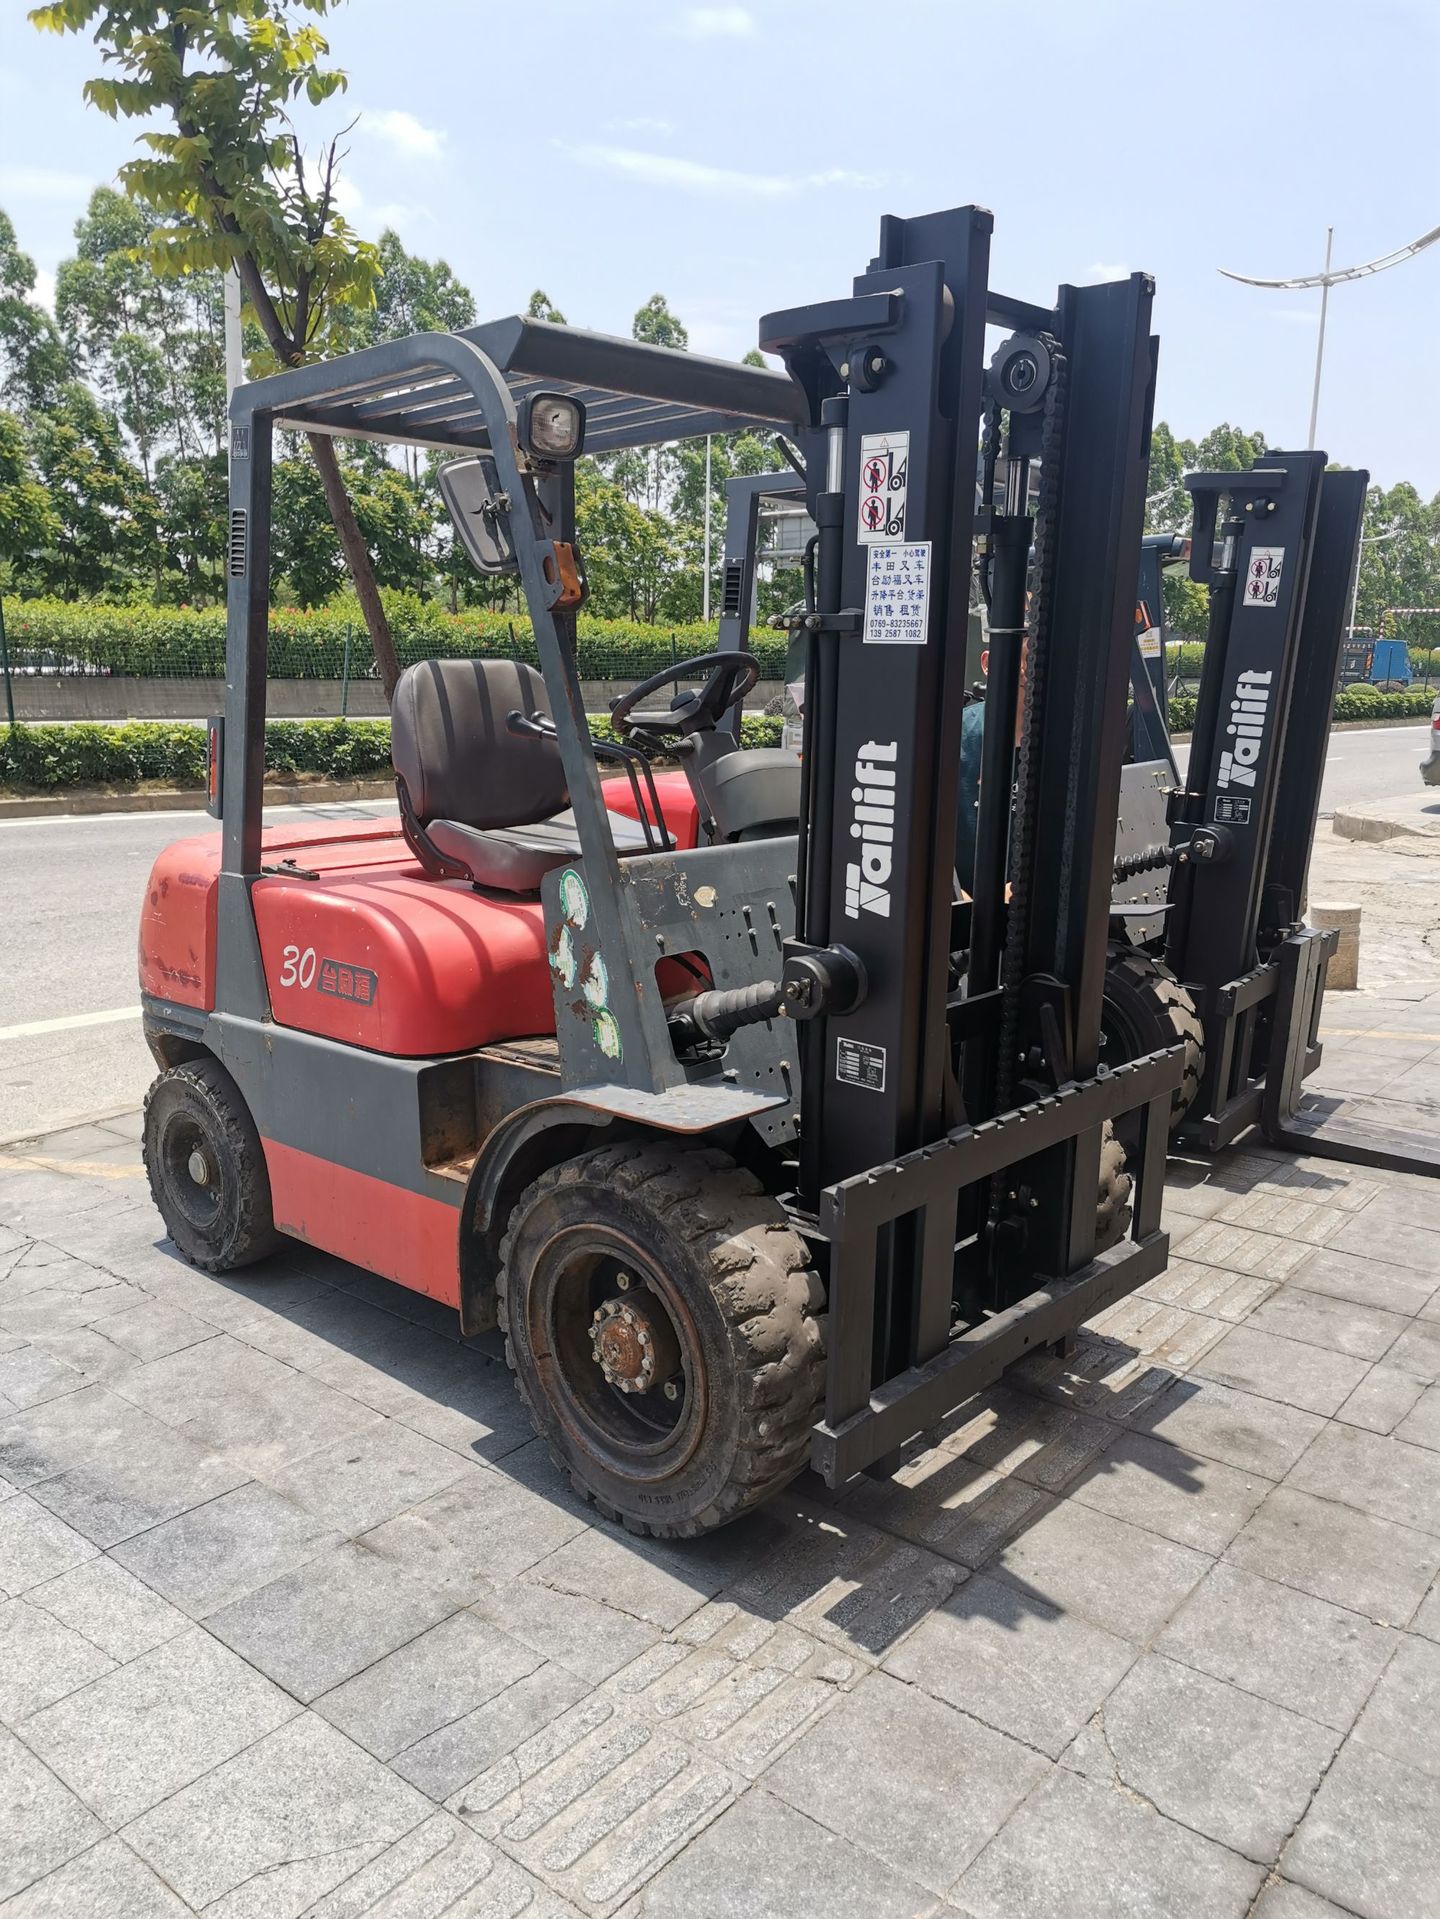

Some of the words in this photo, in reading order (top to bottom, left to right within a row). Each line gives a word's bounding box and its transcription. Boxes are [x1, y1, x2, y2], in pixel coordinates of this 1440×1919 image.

[873, 549, 897, 559] 安全第一
[903, 549, 926, 557] 小心驾驶
[873, 604, 895, 616] 销售
[870, 619, 923, 628] 0769-83235667
[870, 629, 882, 638] 139
[885, 629, 901, 638] 2587
[905, 629, 922, 638] 1082
[1217, 670, 1273, 788] Tailift
[845, 740, 898, 920] Tailift
[280, 945, 316, 989] 30
